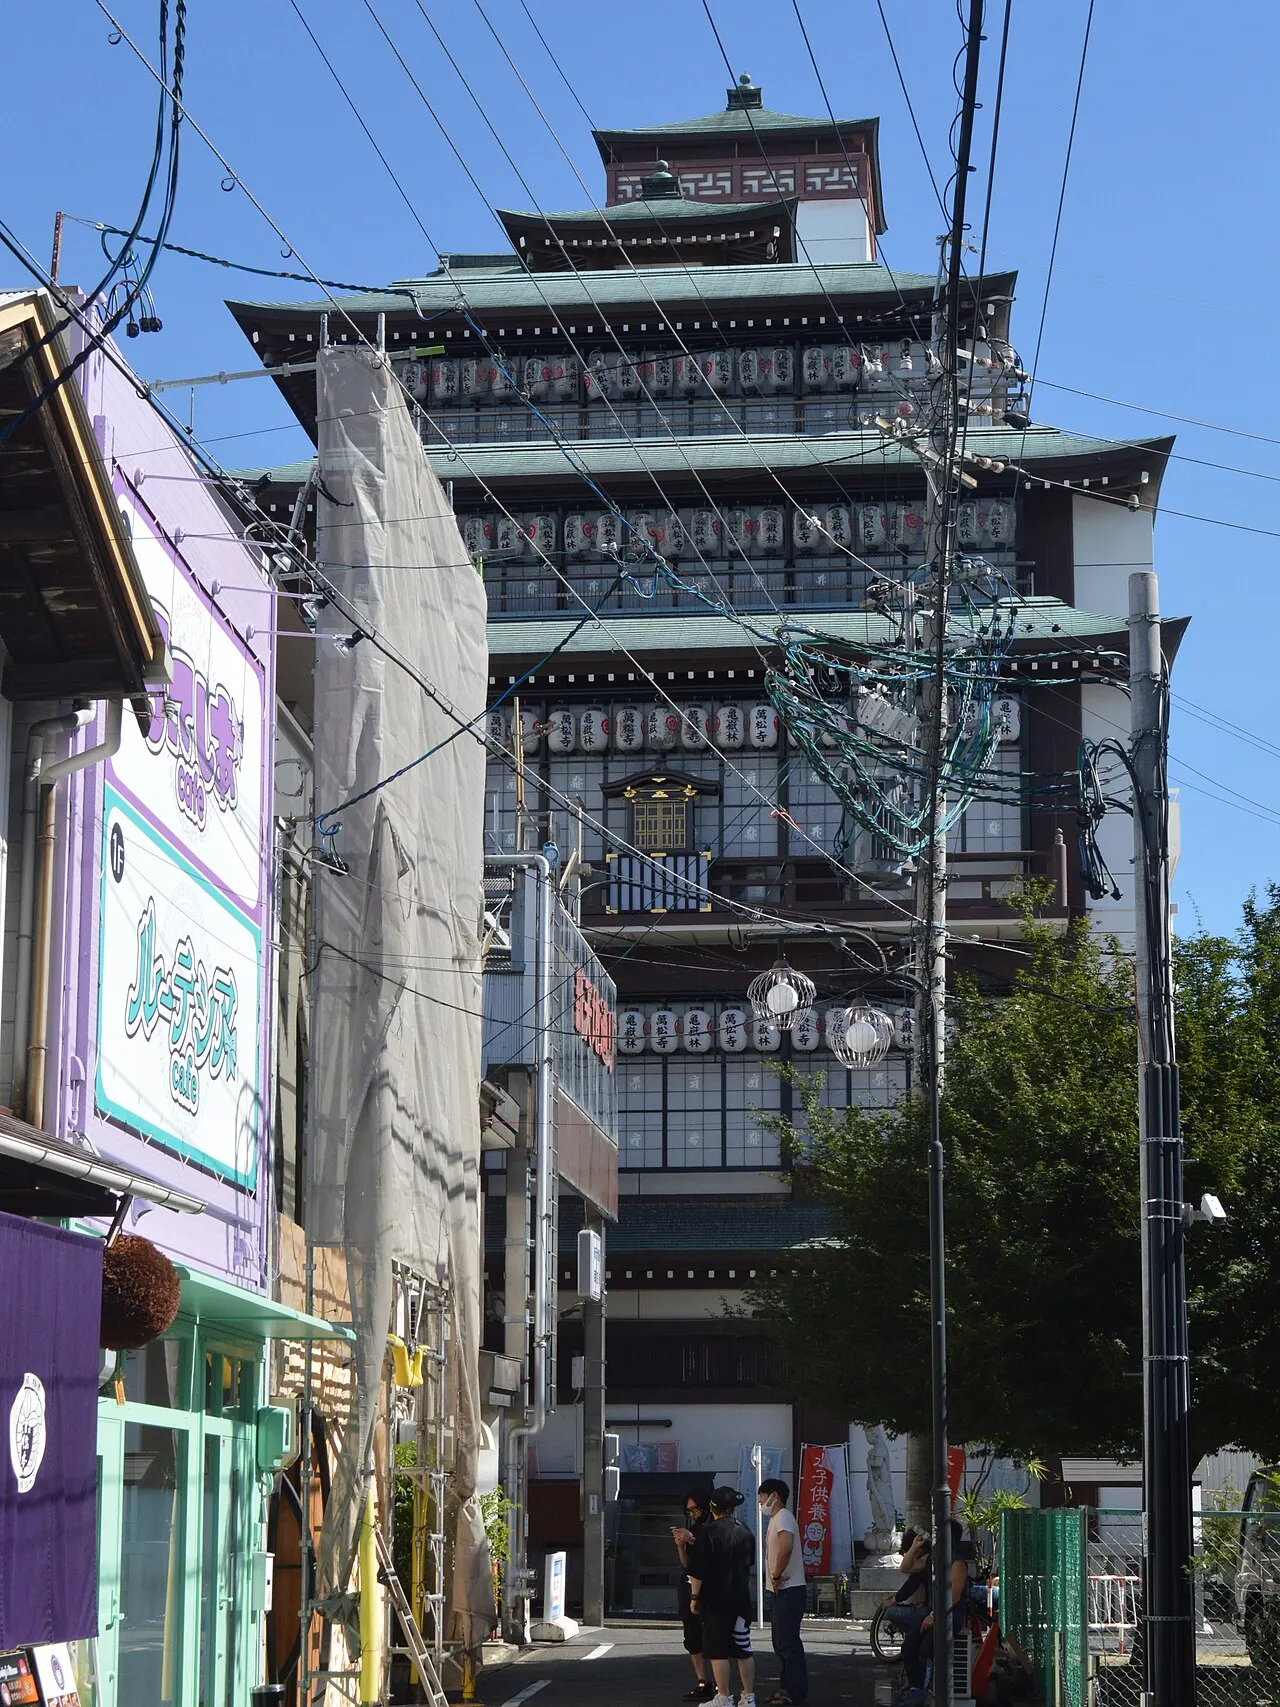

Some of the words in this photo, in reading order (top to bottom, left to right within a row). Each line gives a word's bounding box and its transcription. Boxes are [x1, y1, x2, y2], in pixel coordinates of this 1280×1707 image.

[559, 714, 573, 748] 萬松寺
[583, 713, 595, 747] 亀嶽林
[622, 710, 636, 747] 萬松寺
[727, 708, 739, 742] 亀嶽林
[755, 709, 768, 743] 萬松寺
[177, 763, 205, 824] cafe
[111, 831, 125, 874] 1F
[624, 1014, 638, 1049] 亀嶽林
[656, 1014, 669, 1049] 萬松寺
[688, 1013, 702, 1048] 亀嶽林
[725, 1013, 738, 1048] 萬松寺
[172, 1055, 198, 1104] cafe
